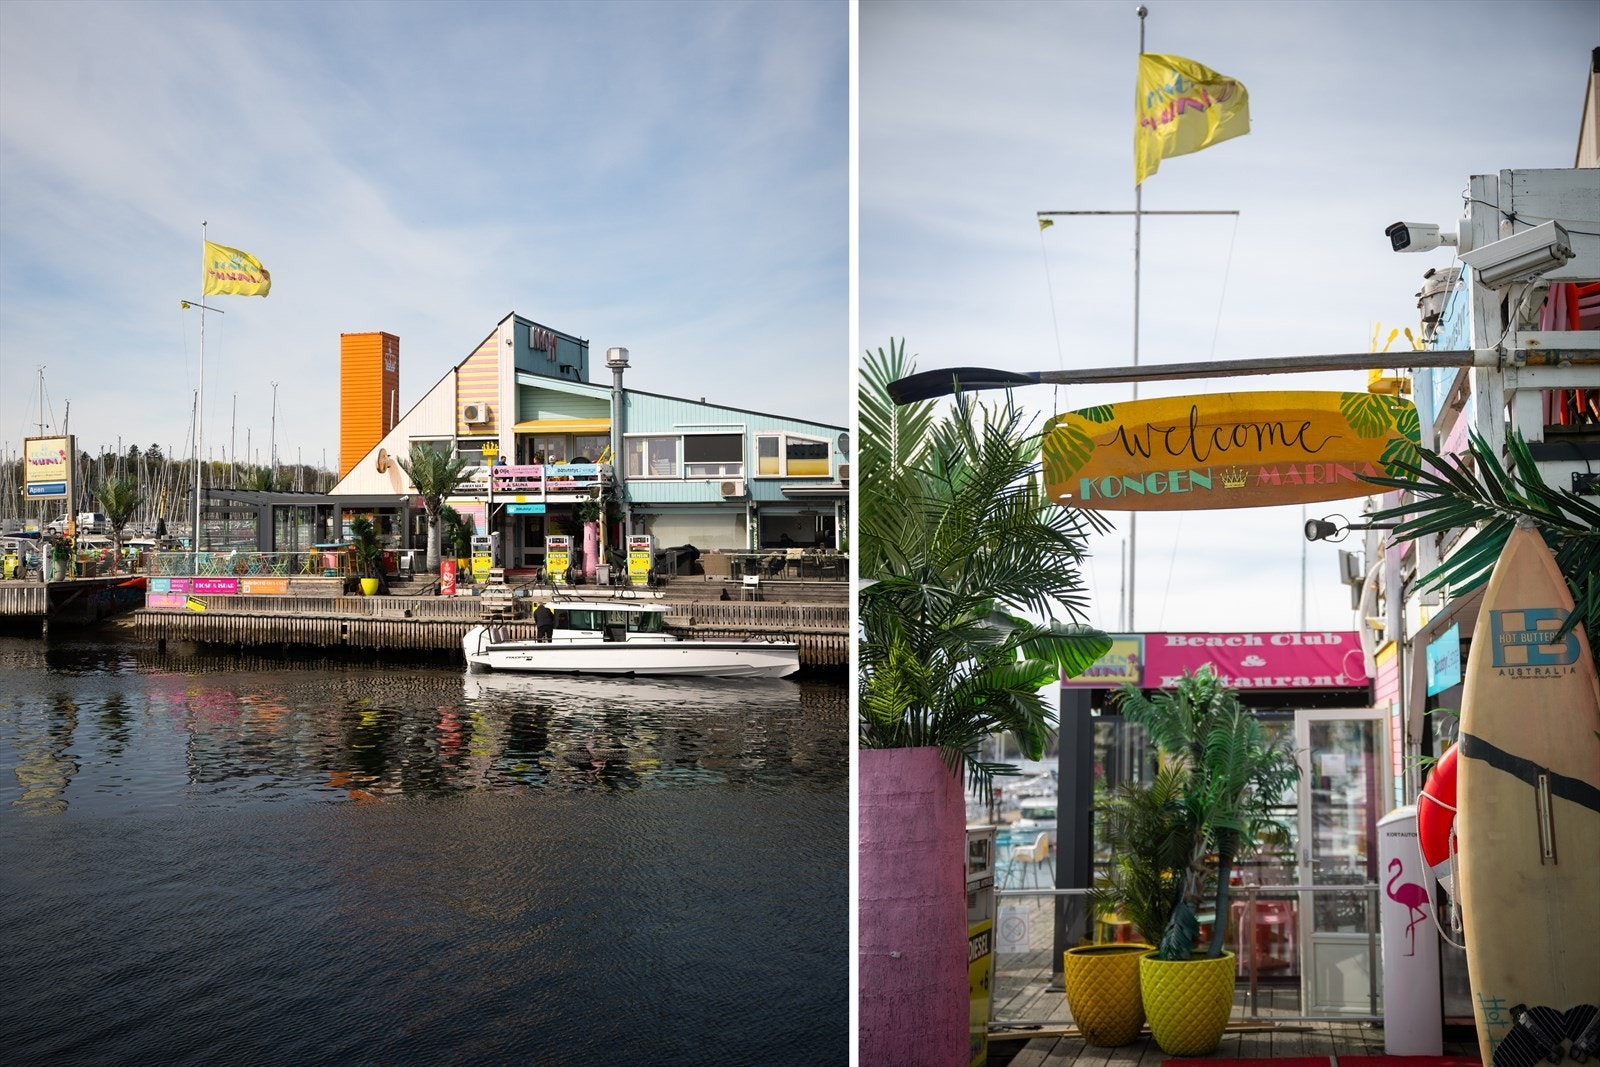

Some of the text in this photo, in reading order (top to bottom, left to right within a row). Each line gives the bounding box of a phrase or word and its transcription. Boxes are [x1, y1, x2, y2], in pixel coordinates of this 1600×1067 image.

[1079, 461, 1380, 501] KONGEN MARINA
[1164, 632, 1343, 647] Beach Club
[1499, 633, 1517, 644] HOT
[1241, 655, 1267, 668] &
[1499, 667, 1576, 676] AUSTRALIA
[968, 933, 989, 962] DIESEL
